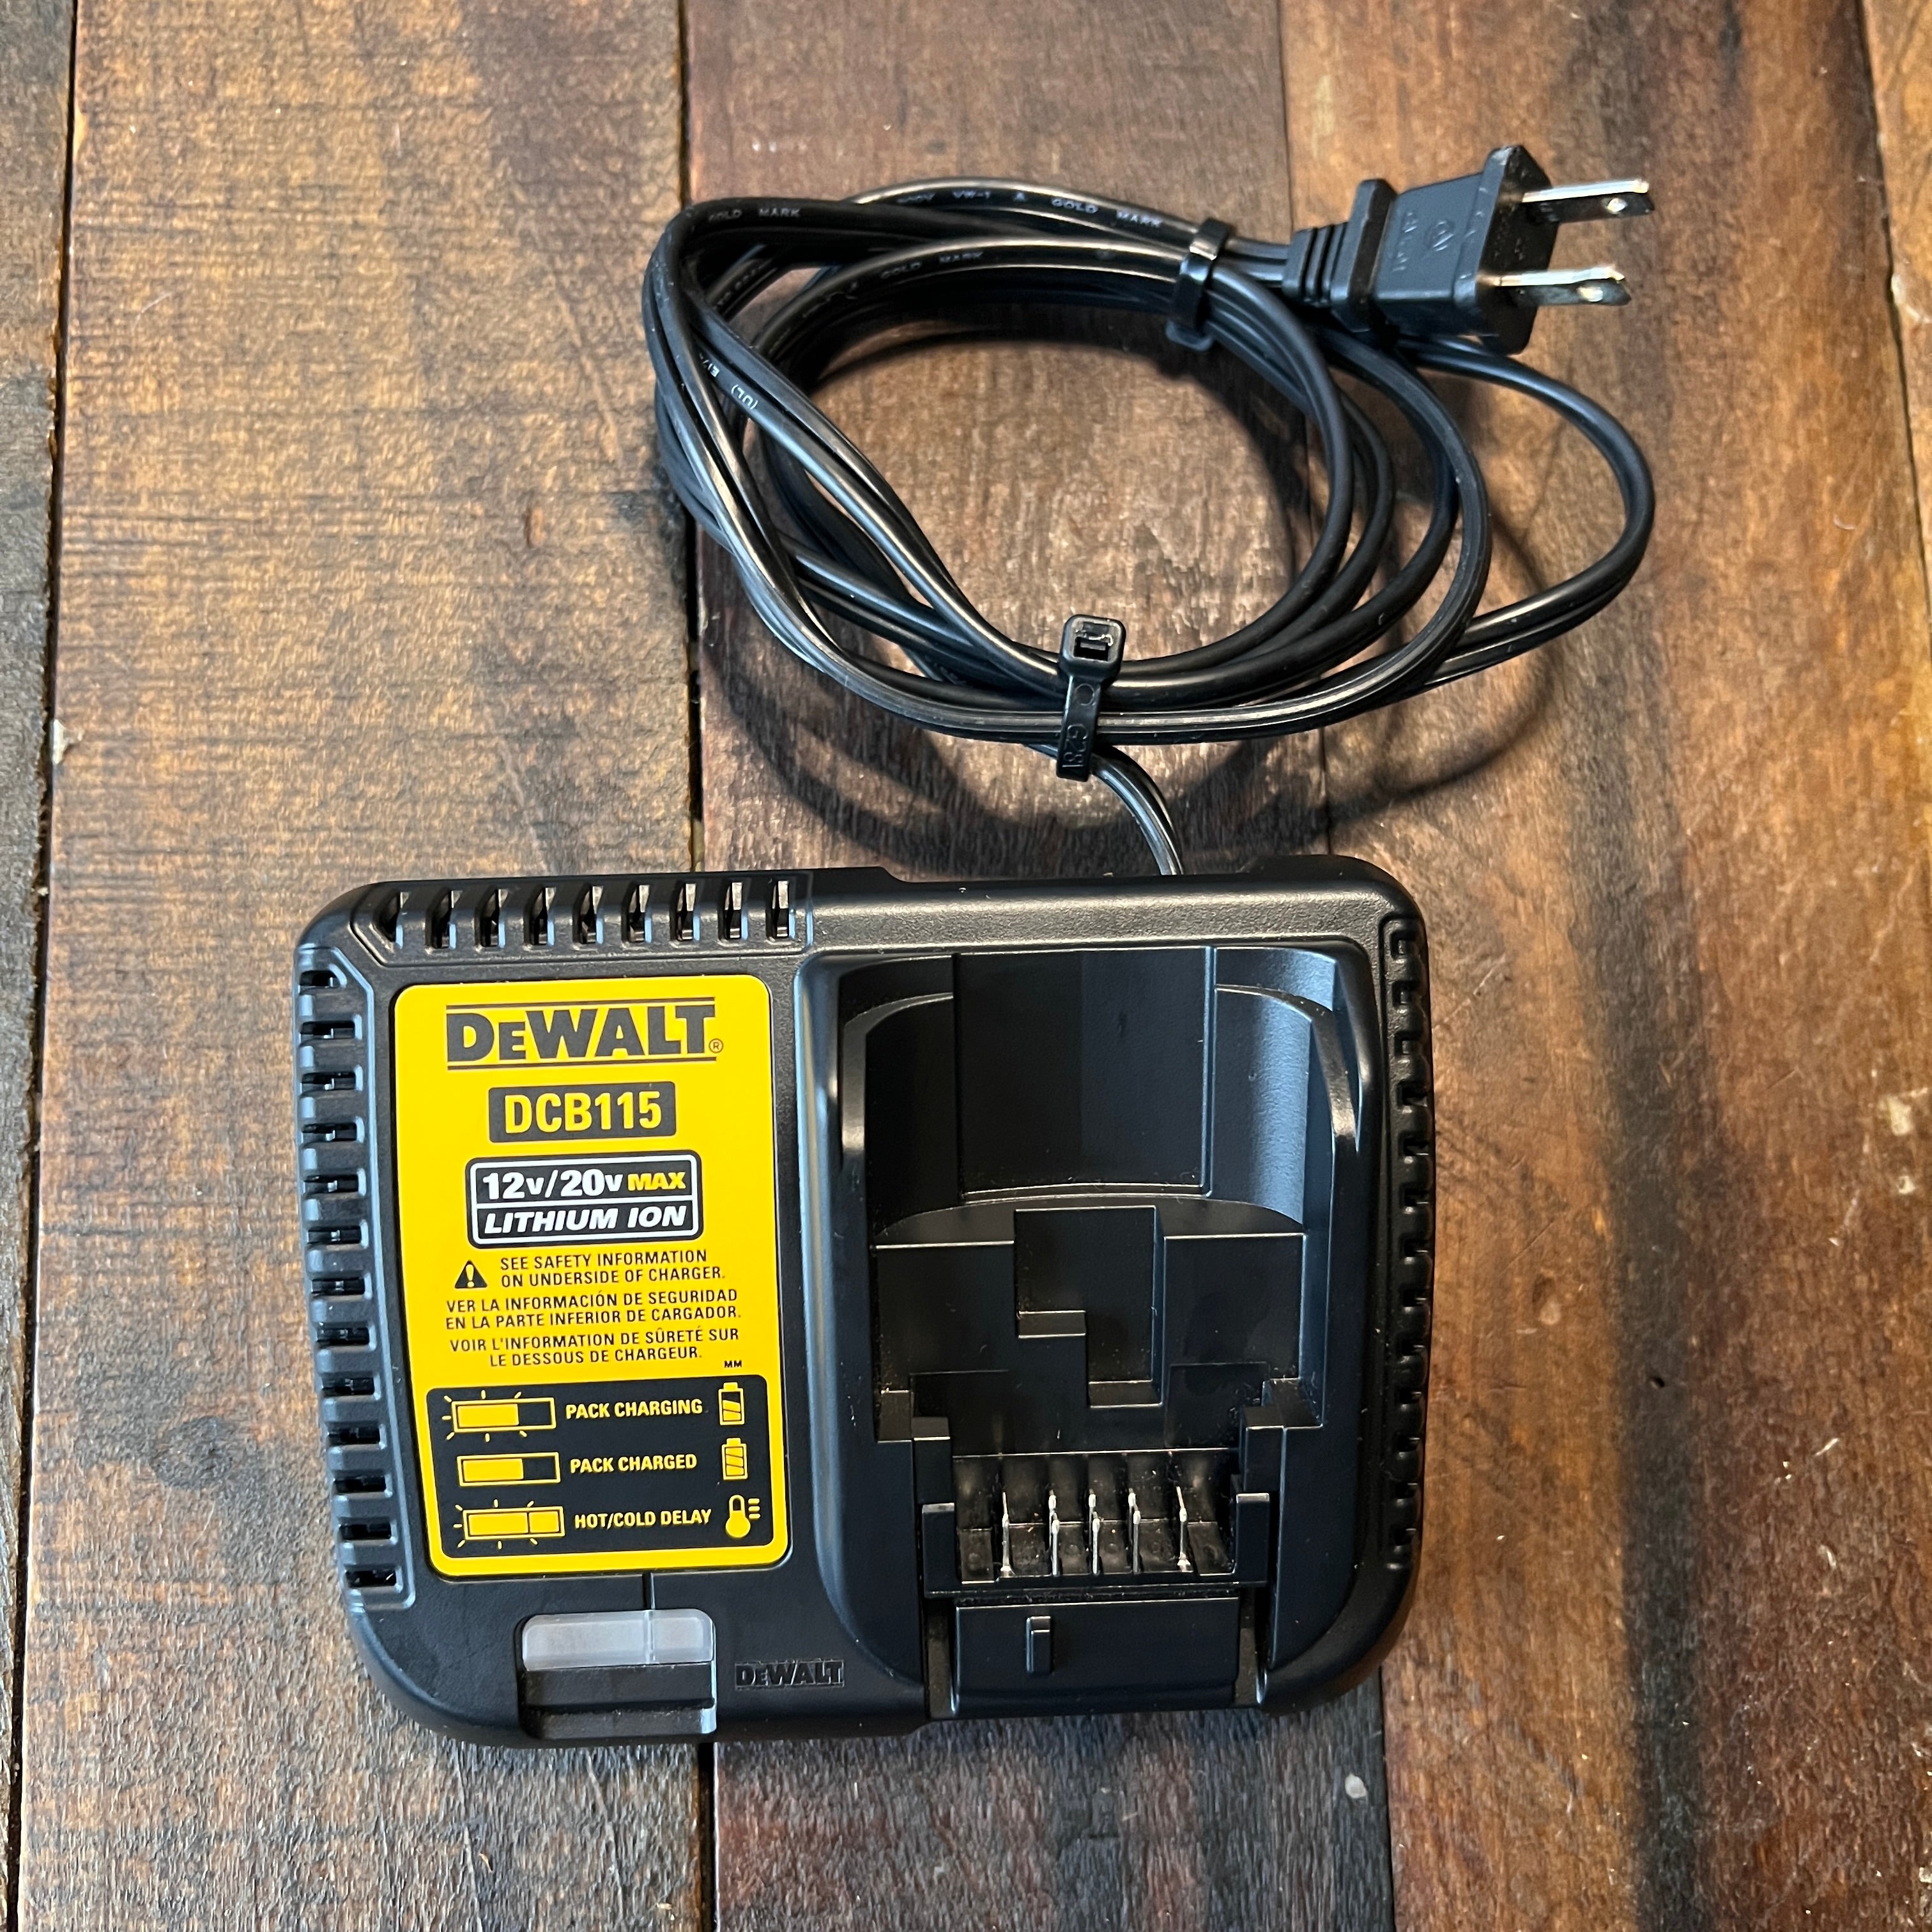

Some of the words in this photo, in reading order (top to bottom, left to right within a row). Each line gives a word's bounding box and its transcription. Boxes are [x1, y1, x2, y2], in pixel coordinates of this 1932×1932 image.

[758, 207, 801, 218] MARK
[1051, 197, 1099, 214] GOLD
[1116, 209, 1163, 227] MARK
[731, 384, 758, 410] (UL)
[503, 1090, 663, 1134] DCB115
[627, 1170, 687, 1192] MAX
[484, 1207, 618, 1235] LITHIUM
[627, 1204, 687, 1229] ION
[500, 1256, 529, 1271] SEE
[534, 1254, 592, 1269] SAFETY
[597, 1248, 707, 1267] INFORMATION
[502, 1273, 523, 1288] ON
[530, 1270, 620, 1287] UNDERSIDE
[624, 1269, 644, 1283] OF
[648, 1266, 726, 1282] CHARGER.
[446, 1299, 476, 1313] VER
[482, 1298, 500, 1312] LA
[505, 1290, 617, 1310] INFORMACIÓN
[624, 1292, 643, 1306] DE
[648, 1289, 738, 1305] SEGURIDAD
[446, 1317, 466, 1330] EN
[472, 1315, 491, 1329] LA
[496, 1313, 545, 1328] PARTE
[550, 1310, 621, 1326] INFERIOR
[627, 1308, 647, 1322] DE
[652, 1306, 742, 1321] CARGADOR.
[449, 1338, 487, 1352] VOIR
[492, 1333, 615, 1351] L'INFORMATION
[620, 1332, 640, 1345] DE
[645, 1325, 703, 1344] SÛRETÉ
[709, 1328, 739, 1341] SUR
[490, 1354, 507, 1367] LE
[512, 1351, 585, 1366] DESSOUS
[590, 1349, 610, 1363] DE
[615, 1346, 703, 1361] CHARGEUR.
[724, 1360, 742, 1368] MM
[565, 1403, 611, 1420] PACK
[614, 1399, 703, 1418] CHARGING
[570, 1457, 615, 1474] PACK
[617, 1453, 698, 1472] CHARGED
[574, 1511, 657, 1530] HOT/COLD
[660, 1508, 712, 1526] DELAY
